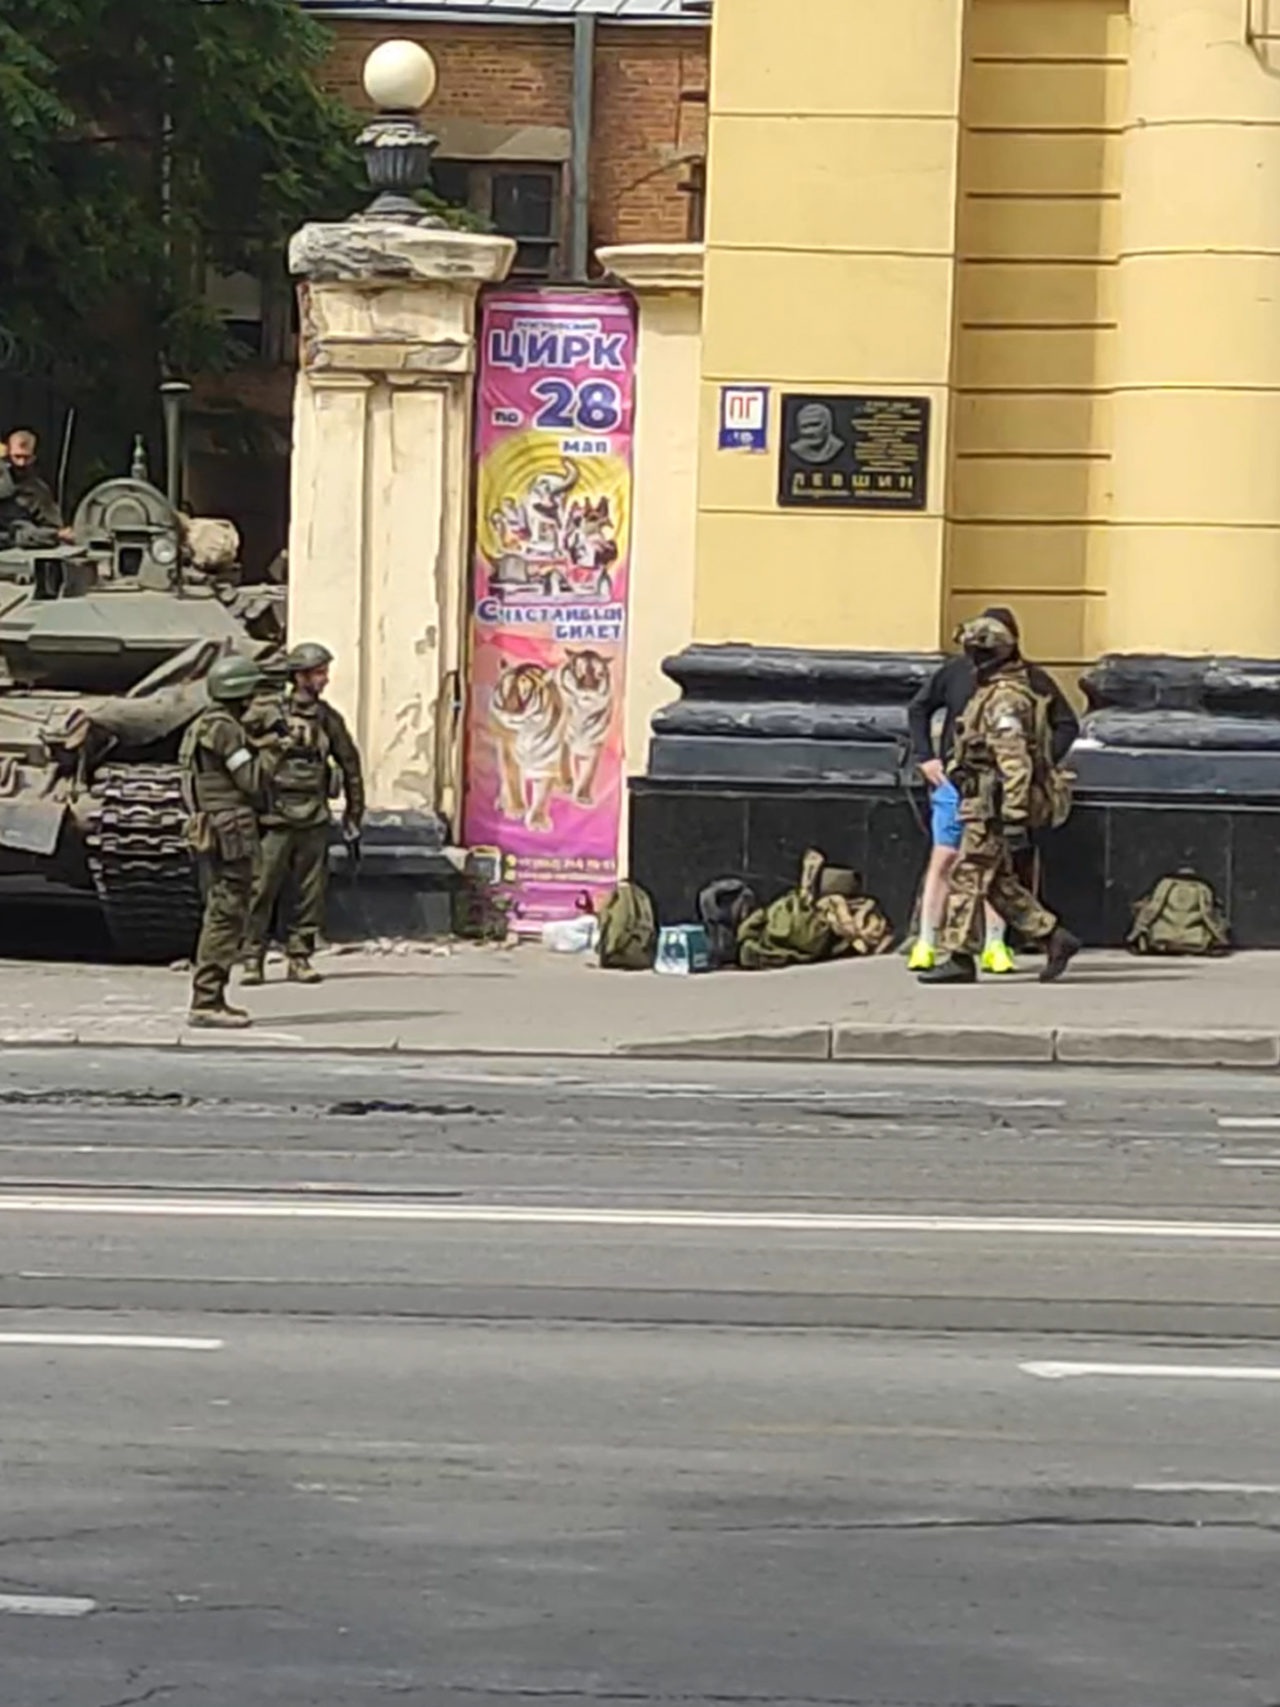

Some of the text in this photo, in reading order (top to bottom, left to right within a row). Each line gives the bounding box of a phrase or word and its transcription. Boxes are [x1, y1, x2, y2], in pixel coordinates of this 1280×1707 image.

[491, 331, 624, 368] ЦИРК
[494, 380, 619, 430] по 28
[729, 395, 759, 419] ПГ
